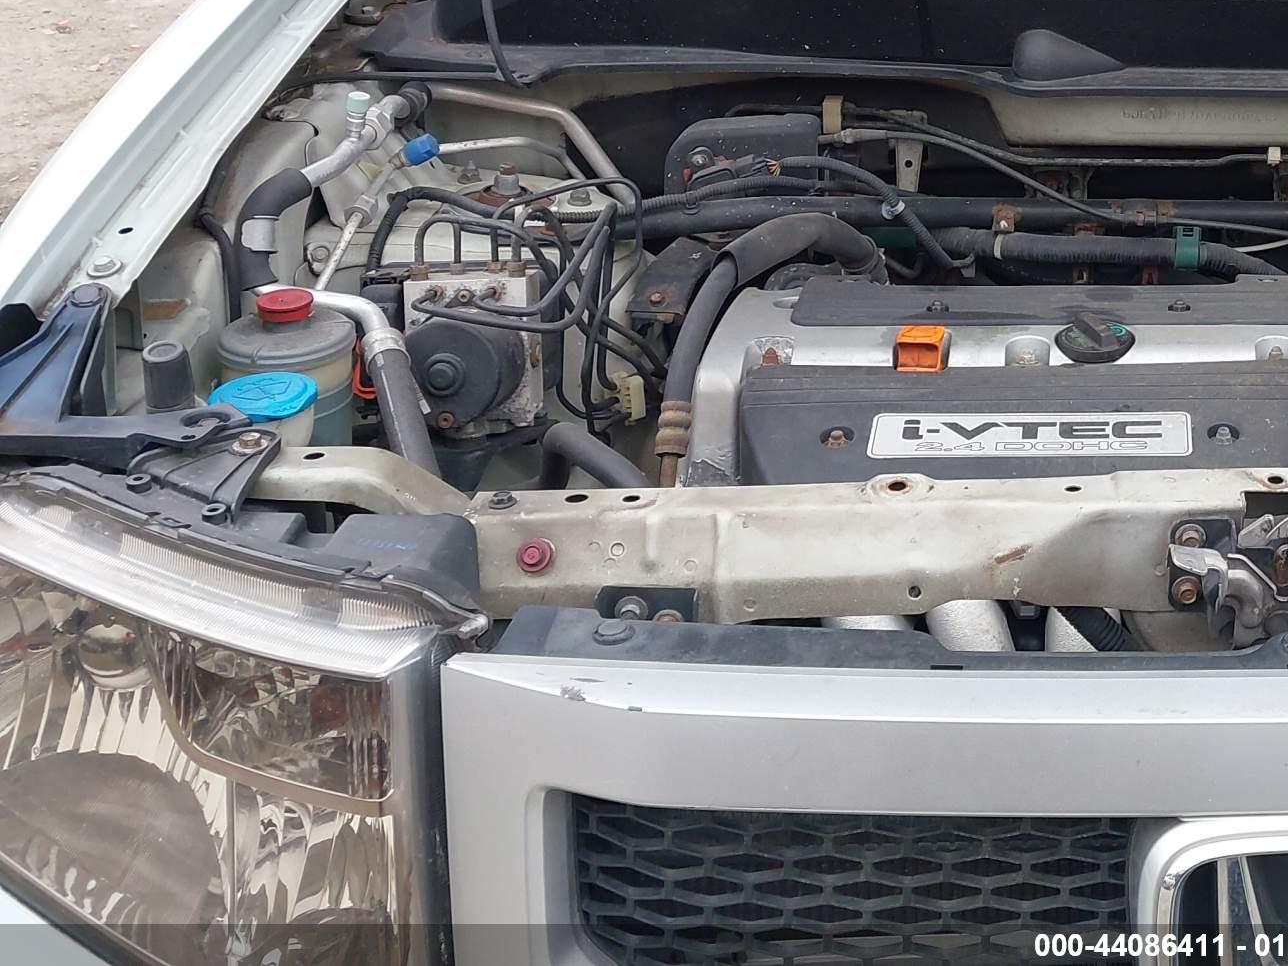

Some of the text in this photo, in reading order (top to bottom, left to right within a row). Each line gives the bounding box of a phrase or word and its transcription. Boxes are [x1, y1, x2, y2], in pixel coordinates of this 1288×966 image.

[902, 419, 1163, 440] i-VTEC
[914, 441, 1149, 452] 2.4 DOHC
